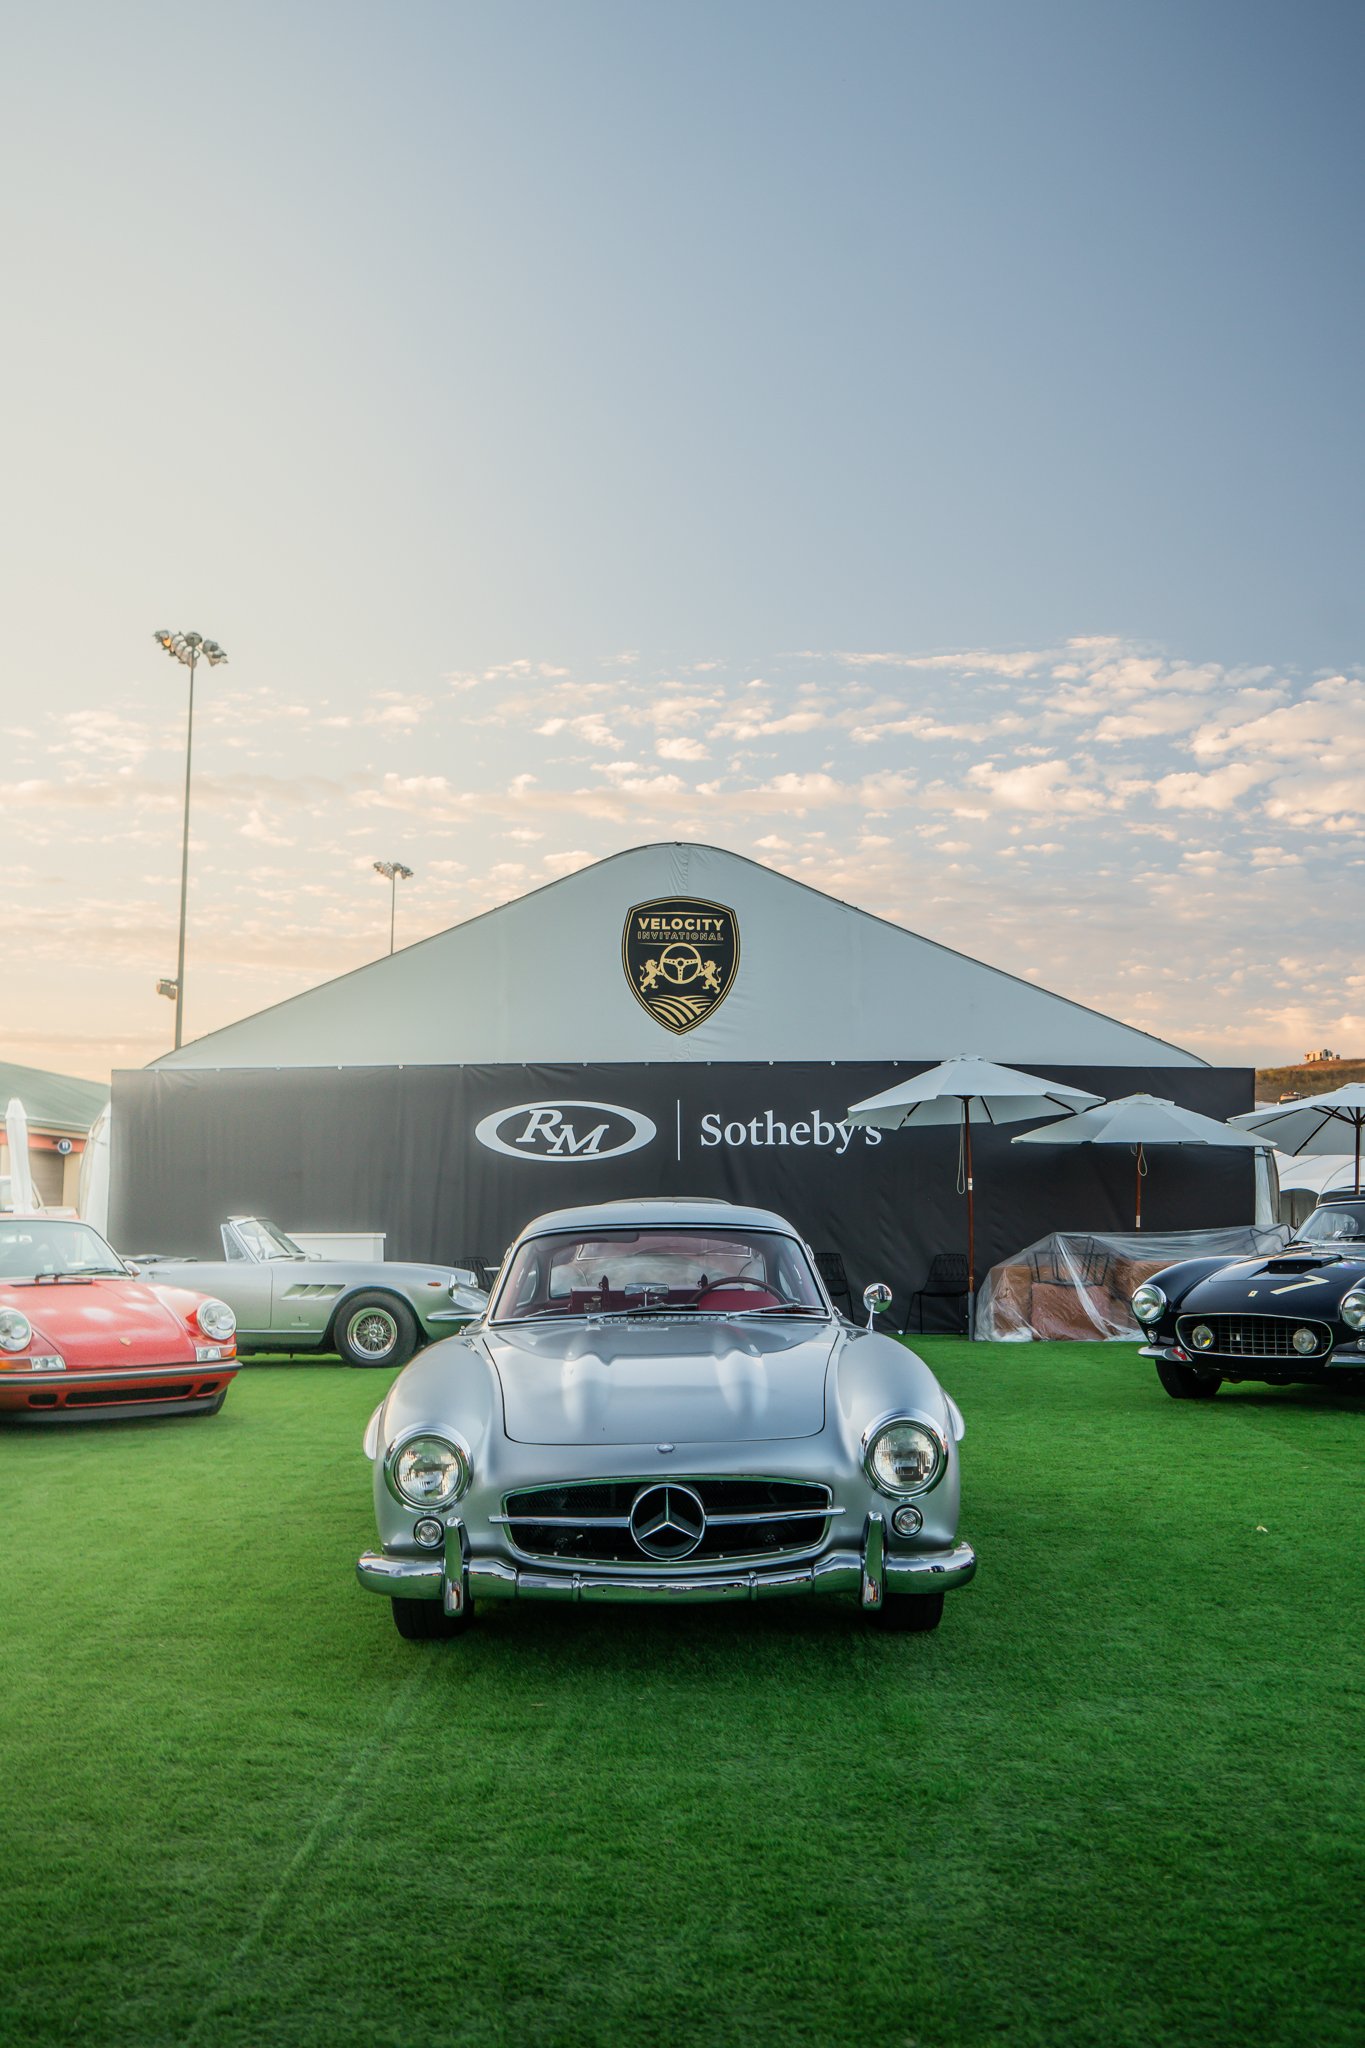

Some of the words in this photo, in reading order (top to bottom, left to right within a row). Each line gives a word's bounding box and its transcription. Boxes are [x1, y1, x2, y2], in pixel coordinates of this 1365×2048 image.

[638, 918, 724, 931] VELOCITY
[637, 931, 724, 941] INVITATIONAL
[515, 1109, 610, 1154] RM
[701, 1110, 882, 1154] Sothebys
[1270, 1274, 1330, 1295] 7
